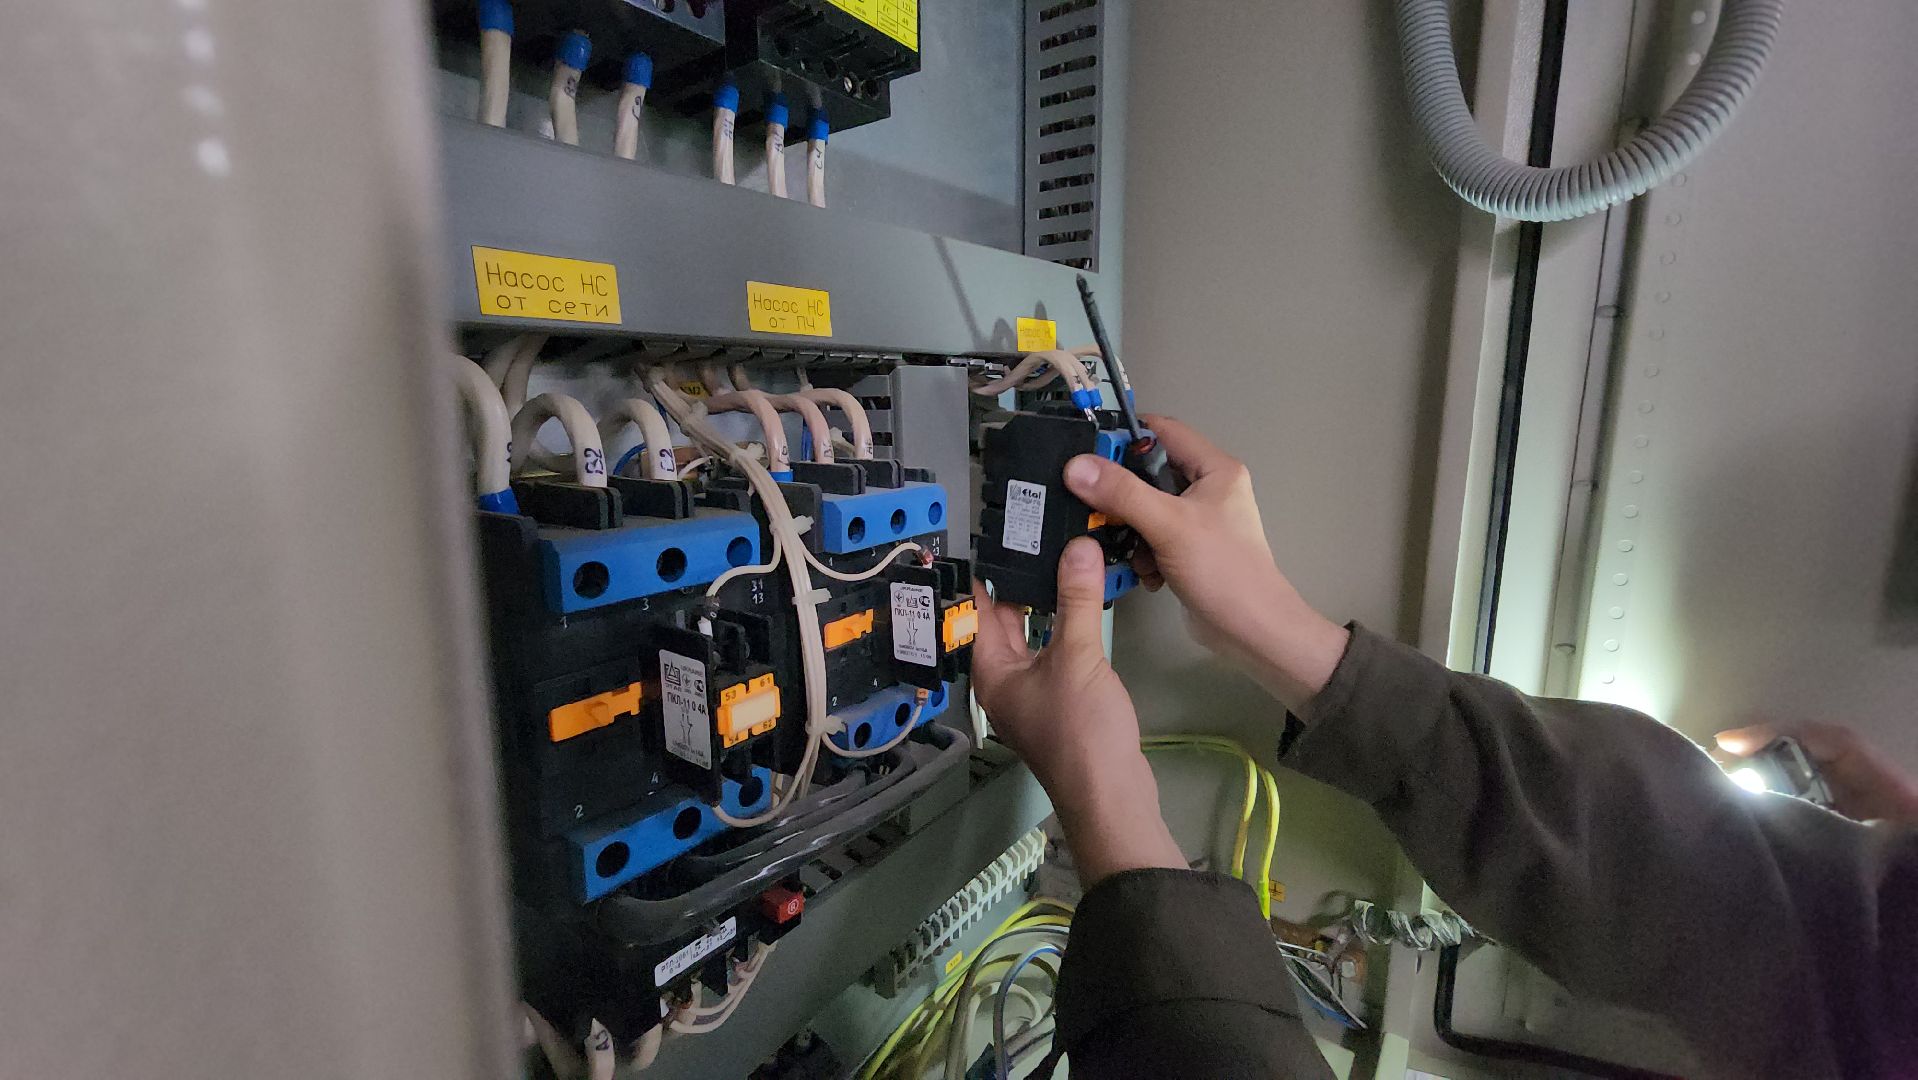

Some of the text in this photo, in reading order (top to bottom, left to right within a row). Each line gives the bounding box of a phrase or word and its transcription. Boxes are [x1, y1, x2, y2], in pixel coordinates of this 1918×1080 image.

[486, 262, 608, 297] Насос НС
[497, 295, 608, 317] от сети
[753, 292, 824, 317] Насос НС
[769, 315, 815, 332] от ПЧ
[829, 557, 833, 567] 1
[751, 578, 763, 591] 31
[642, 598, 650, 611] 3
[752, 592, 764, 605] 13
[561, 616, 568, 628] 1
[832, 696, 837, 706] 2
[574, 804, 583, 818] 2
